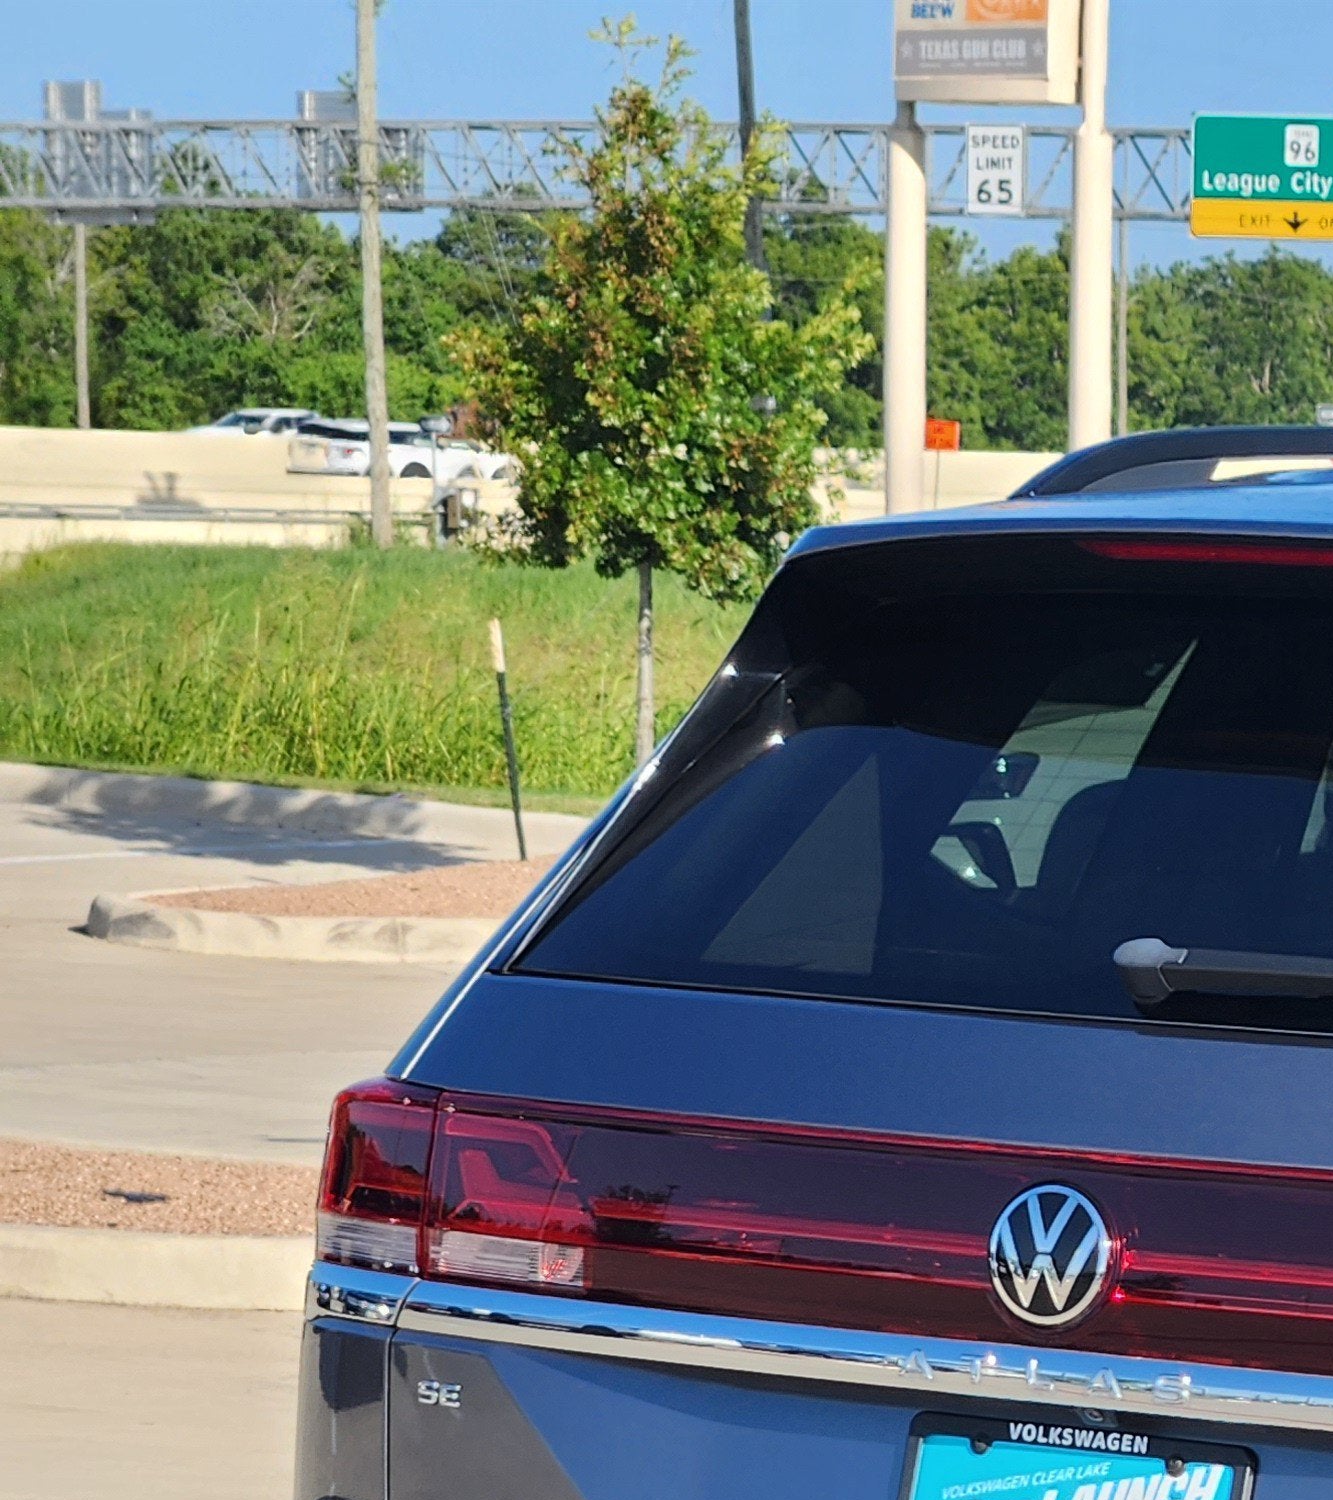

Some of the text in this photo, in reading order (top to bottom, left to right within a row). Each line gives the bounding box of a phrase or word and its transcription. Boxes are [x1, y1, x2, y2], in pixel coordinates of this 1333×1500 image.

[919, 37, 1026, 60] TEXAS GUN CLUB
[971, 134, 1020, 149] SPEED
[1290, 140, 1316, 162] 96
[976, 156, 1013, 171] LIMIT
[977, 178, 1013, 204] 65
[1202, 169, 1281, 197] League
[1290, 171, 1333, 200] City
[1239, 213, 1271, 229] EXIT
[417, 1381, 462, 1408] SE
[1009, 1422, 1149, 1454] VOLKSWAGEN
[941, 1462, 1112, 1500] VOLKSWAGEN CLEAR LAKE
